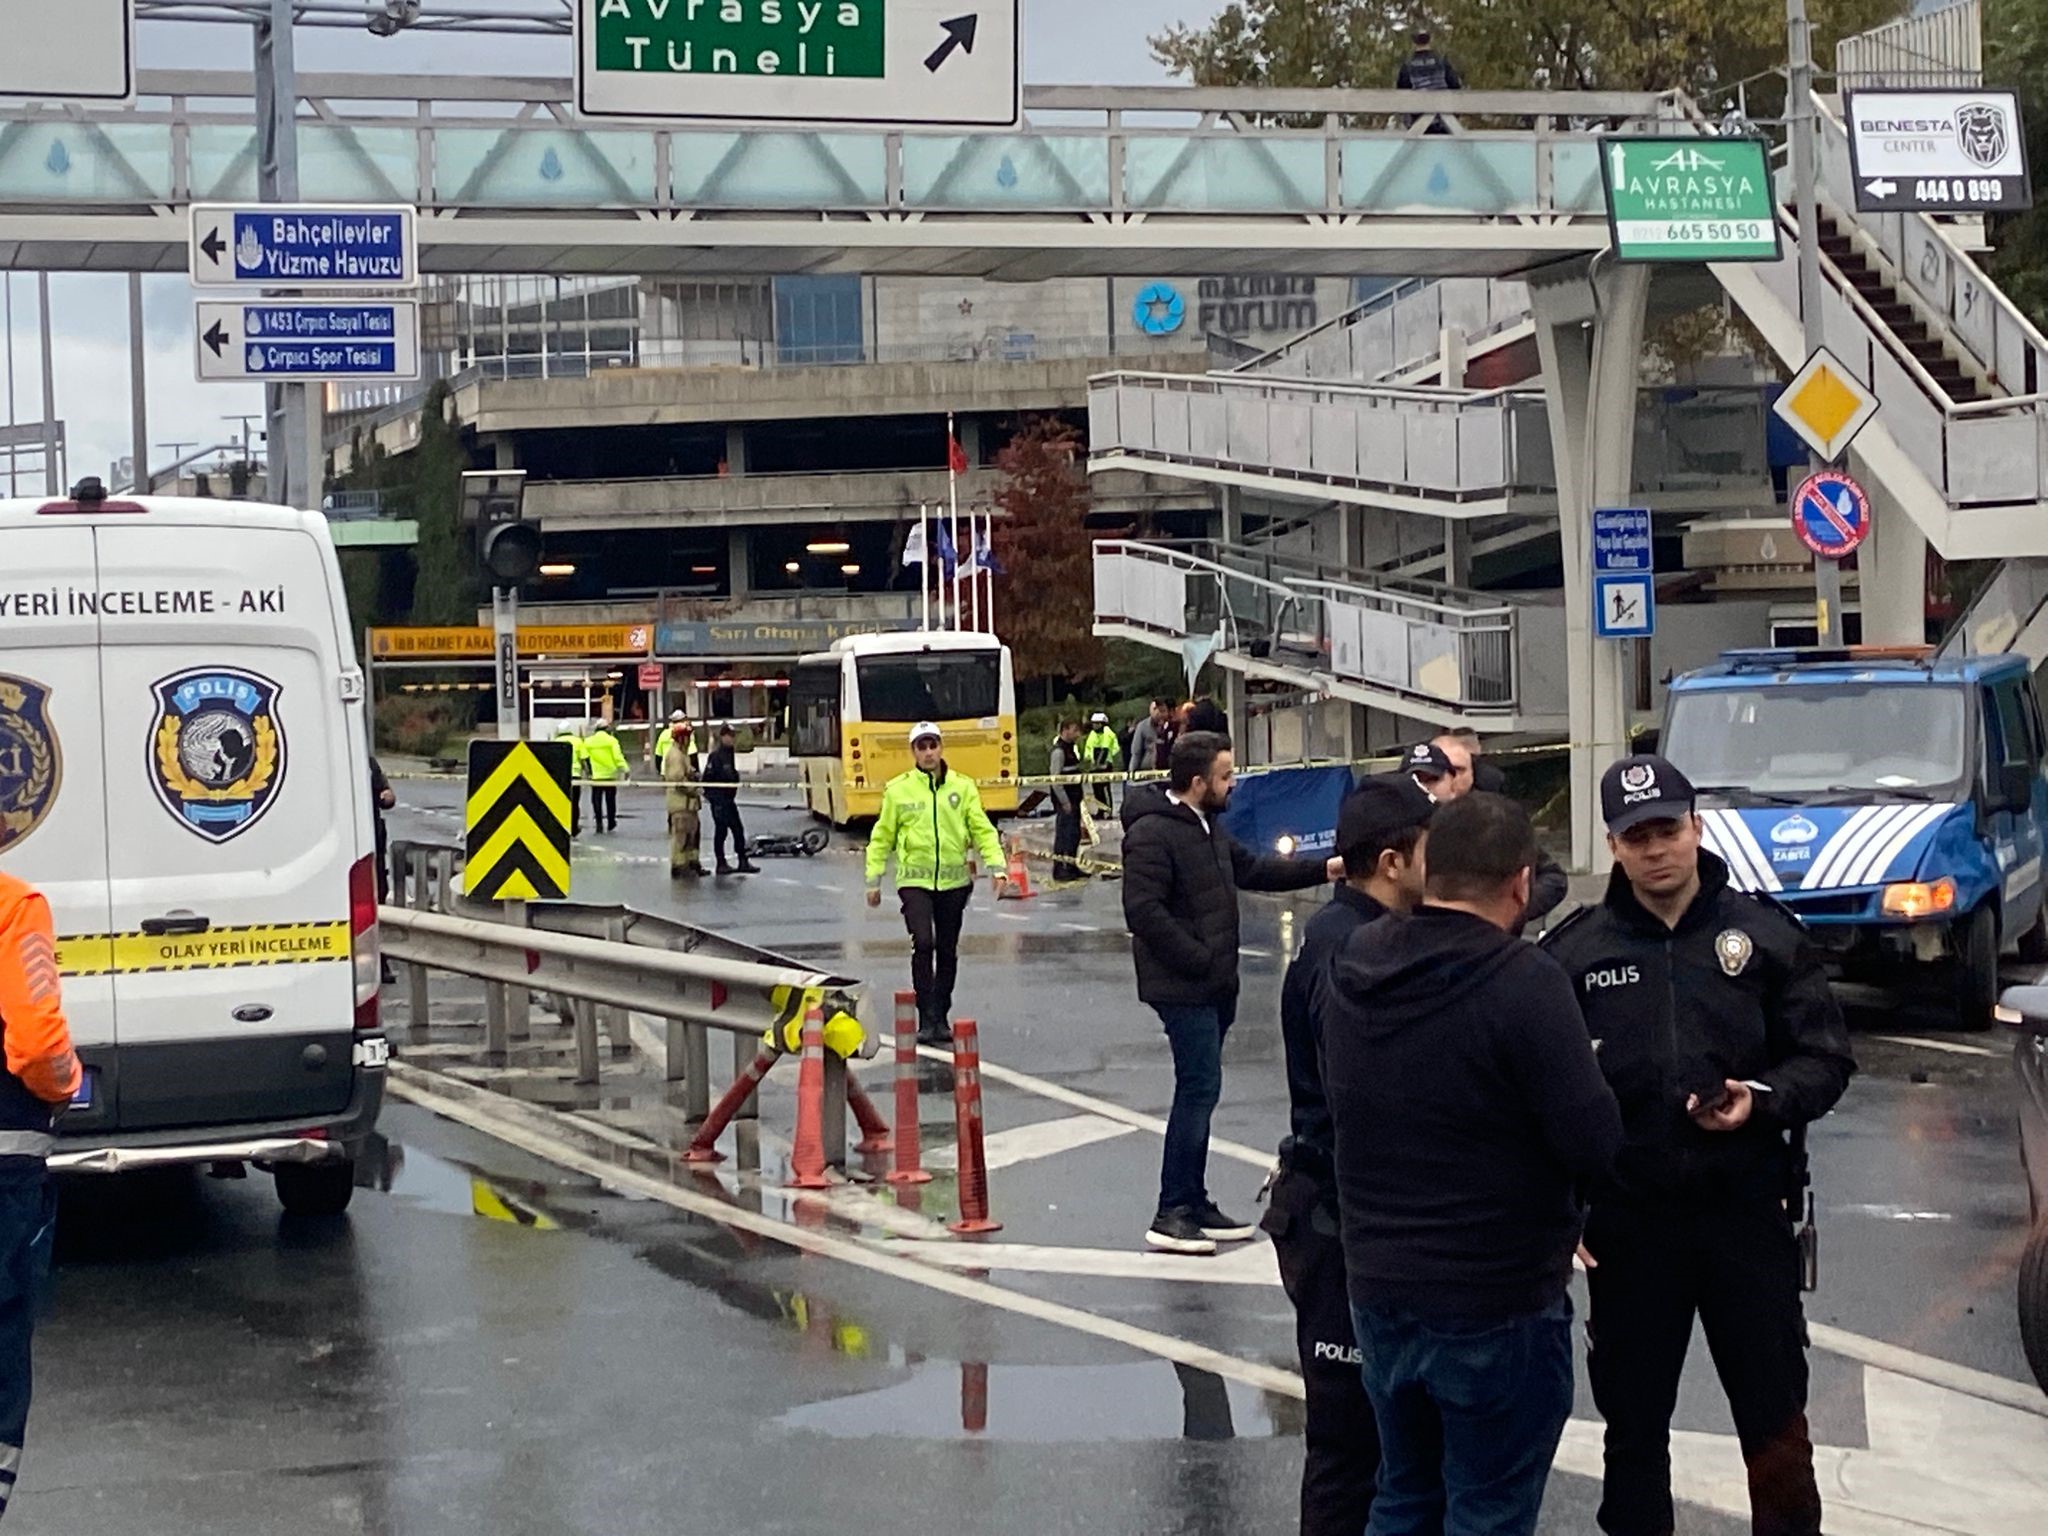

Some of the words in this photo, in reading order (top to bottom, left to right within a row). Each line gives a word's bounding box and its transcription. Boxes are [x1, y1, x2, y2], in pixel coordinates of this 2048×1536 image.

[599, 0, 860, 33] Avrasya
[625, 37, 835, 75] Tüneli
[1861, 120, 1954, 133] BENESTA
[1883, 140, 1937, 153] CENTER
[1629, 176, 1753, 195] AVRASYA
[1915, 180, 1950, 202] 444
[1952, 180, 1965, 201] 0
[1968, 180, 2002, 201] 899
[272, 217, 393, 248] Bahçelievler
[1667, 224, 1704, 241] 665
[1708, 224, 1732, 240] 50
[1736, 223, 1760, 240] 50
[266, 249, 329, 276] Yüzme
[334, 249, 403, 275] Havuzu
[264, 311, 294, 331] 1453
[312, 346, 344, 370] Spor
[345, 346, 382, 367] Tesisi
[68, 586, 215, 616] İNCELEME
[238, 584, 286, 613] AKİ
[159, 945, 204, 959] OLAY
[209, 938, 245, 956] YERİ
[249, 935, 332, 955] İNCELEME
